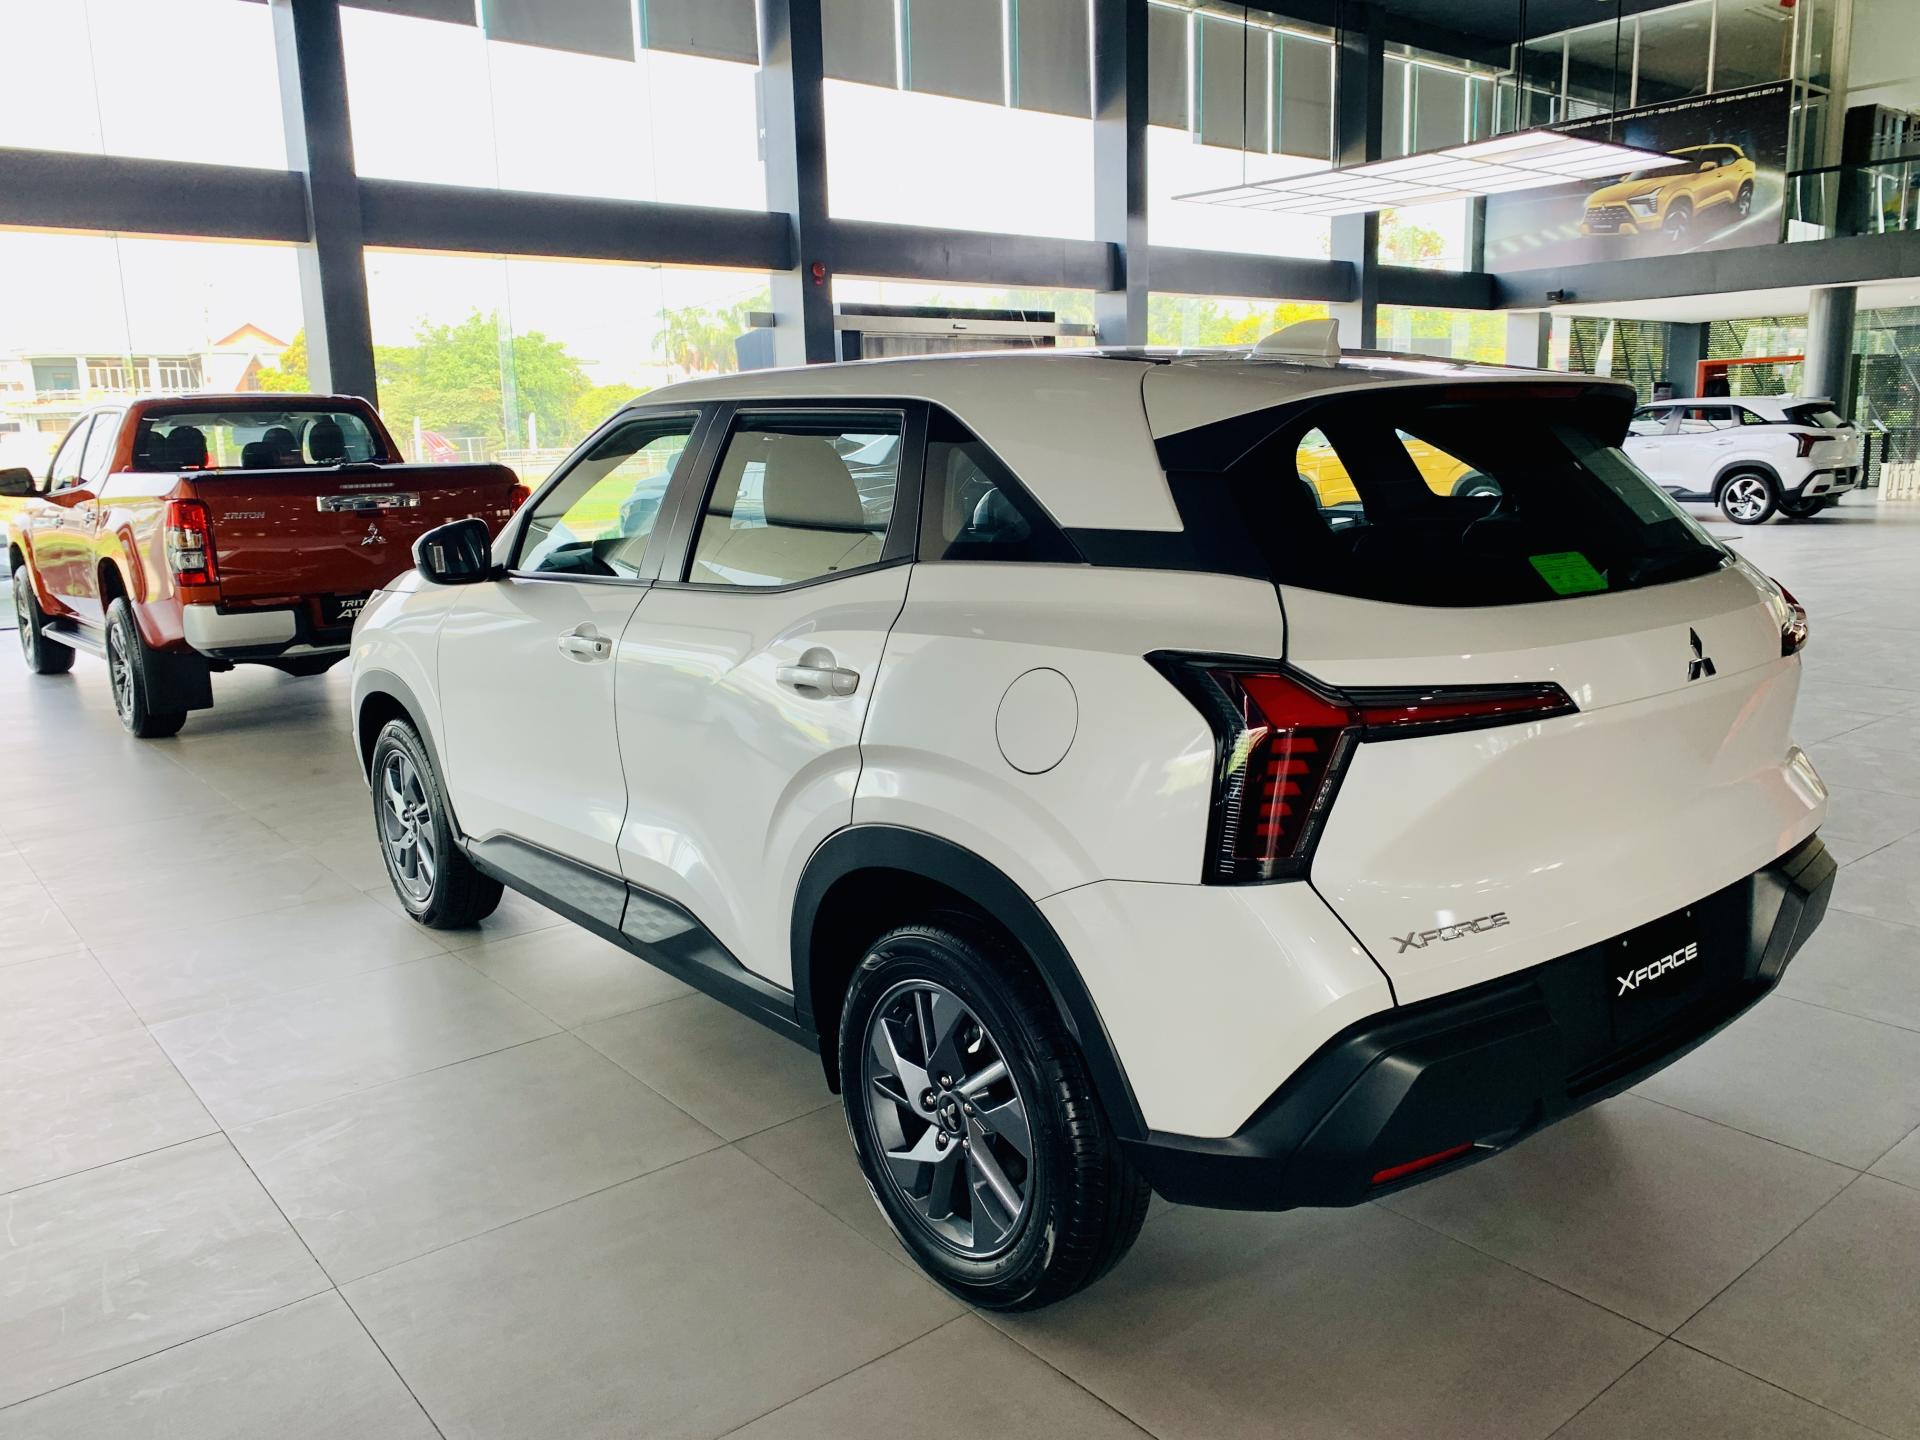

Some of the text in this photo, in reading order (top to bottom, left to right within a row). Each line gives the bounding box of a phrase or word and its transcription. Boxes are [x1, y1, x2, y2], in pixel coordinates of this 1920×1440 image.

[223, 511, 265, 520] TRITON
[340, 599, 368, 608] TRIT
[336, 607, 362, 619] AT
[1390, 912, 1510, 954] XFORCE
[1616, 941, 1698, 997] XFORCE
